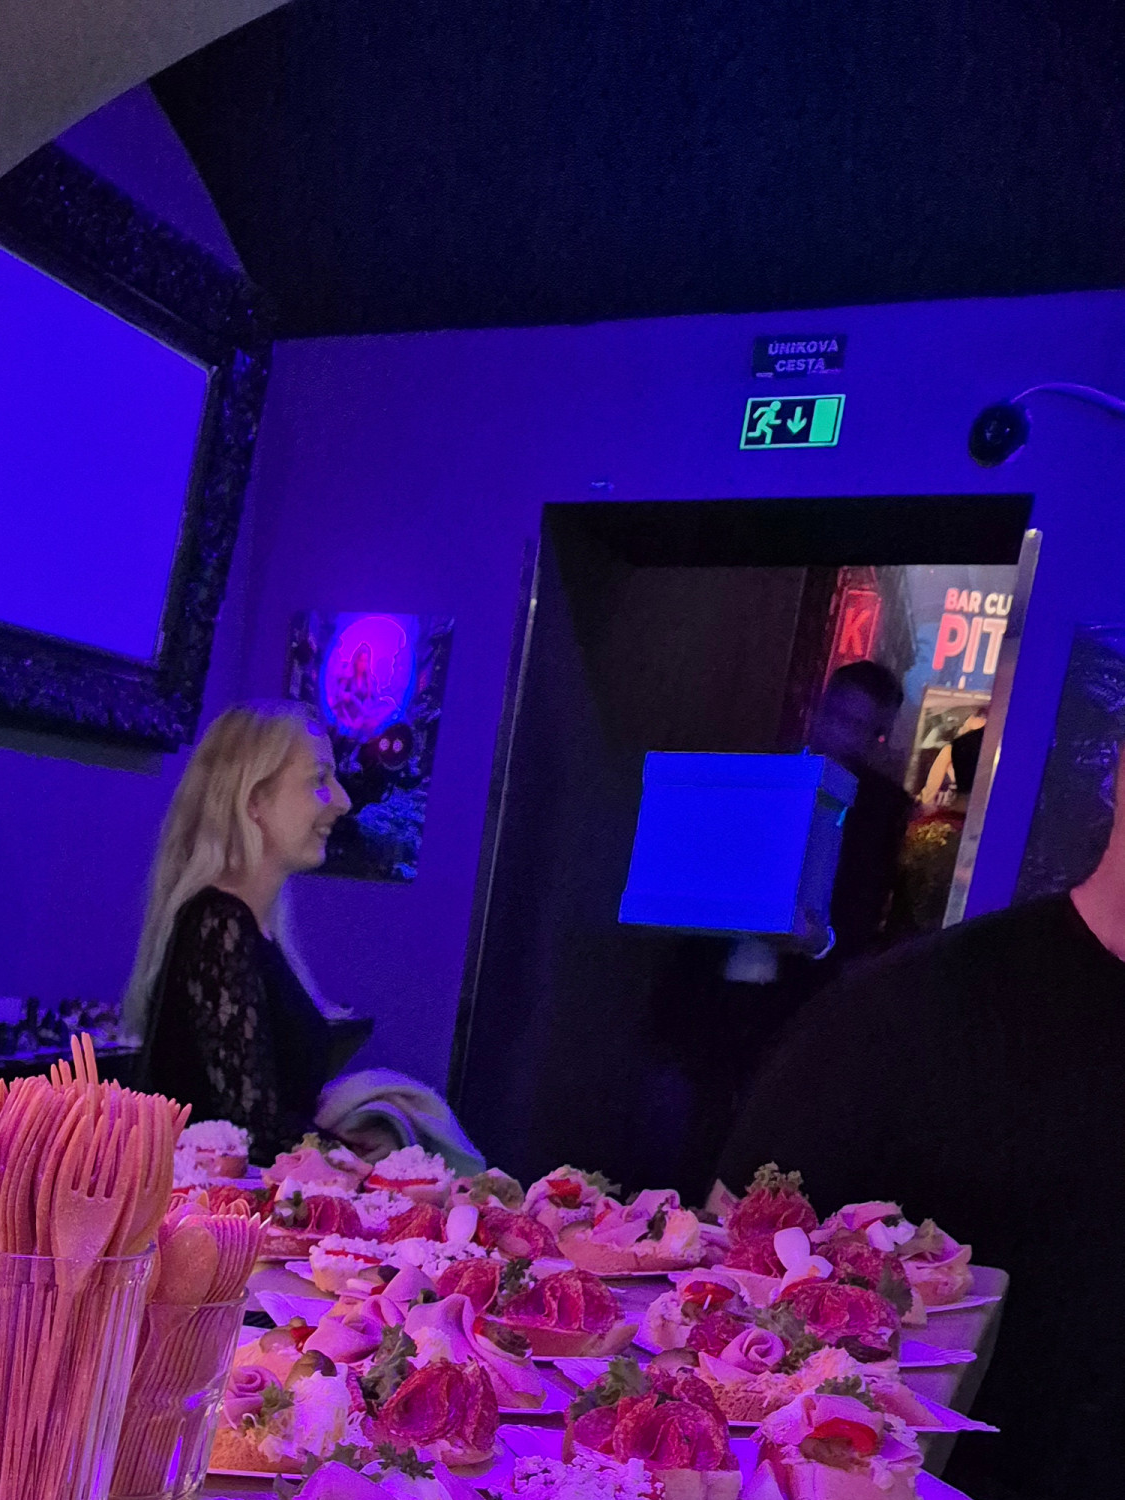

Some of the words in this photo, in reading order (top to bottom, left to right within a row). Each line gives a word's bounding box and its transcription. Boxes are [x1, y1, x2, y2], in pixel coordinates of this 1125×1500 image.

[775, 358, 826, 372] CESTA
[944, 588, 982, 614] BAR
[838, 607, 872, 656] K
[932, 613, 1008, 675] PIT
